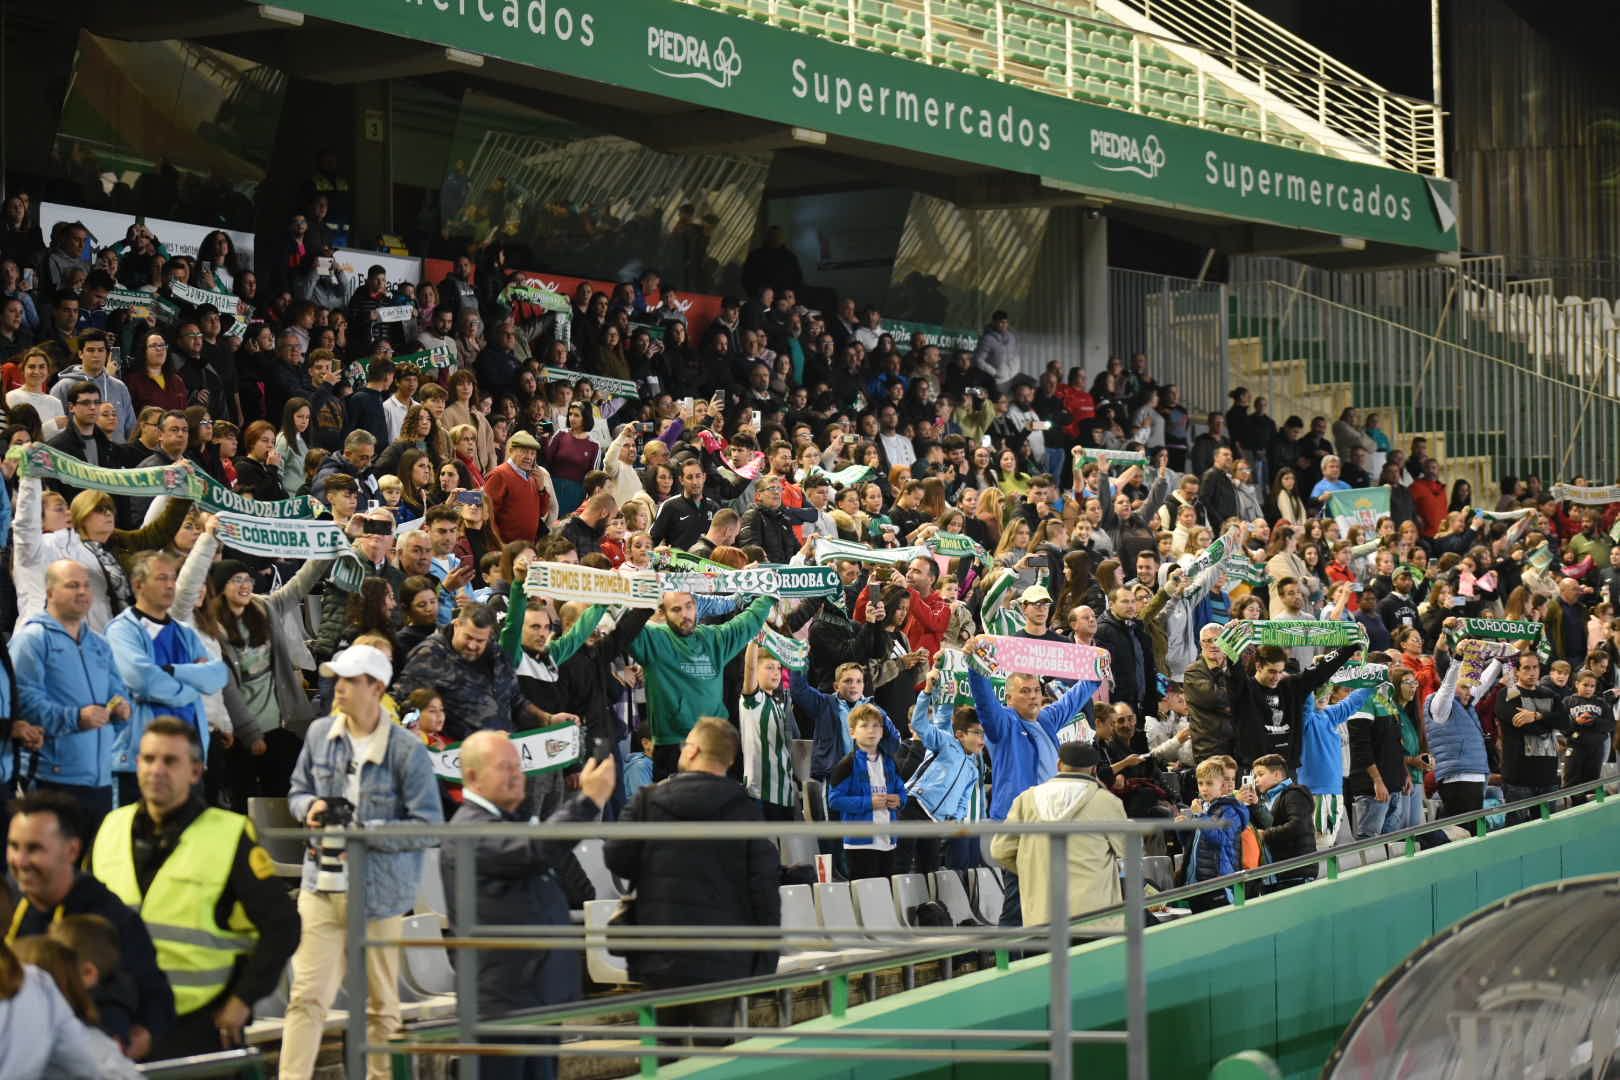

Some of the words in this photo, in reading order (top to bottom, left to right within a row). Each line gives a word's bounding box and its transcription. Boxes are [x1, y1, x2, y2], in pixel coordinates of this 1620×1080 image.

[405, 0, 595, 46] cados
[792, 57, 1051, 151] Supermercados
[1205, 150, 1412, 221] Supermercados
[241, 523, 310, 548] CÓRDOBA
[550, 569, 579, 590] SOMOS
[580, 573, 592, 592] DE
[1527, 623, 1541, 635] CF
[1027, 644, 1065, 659] MUJER
